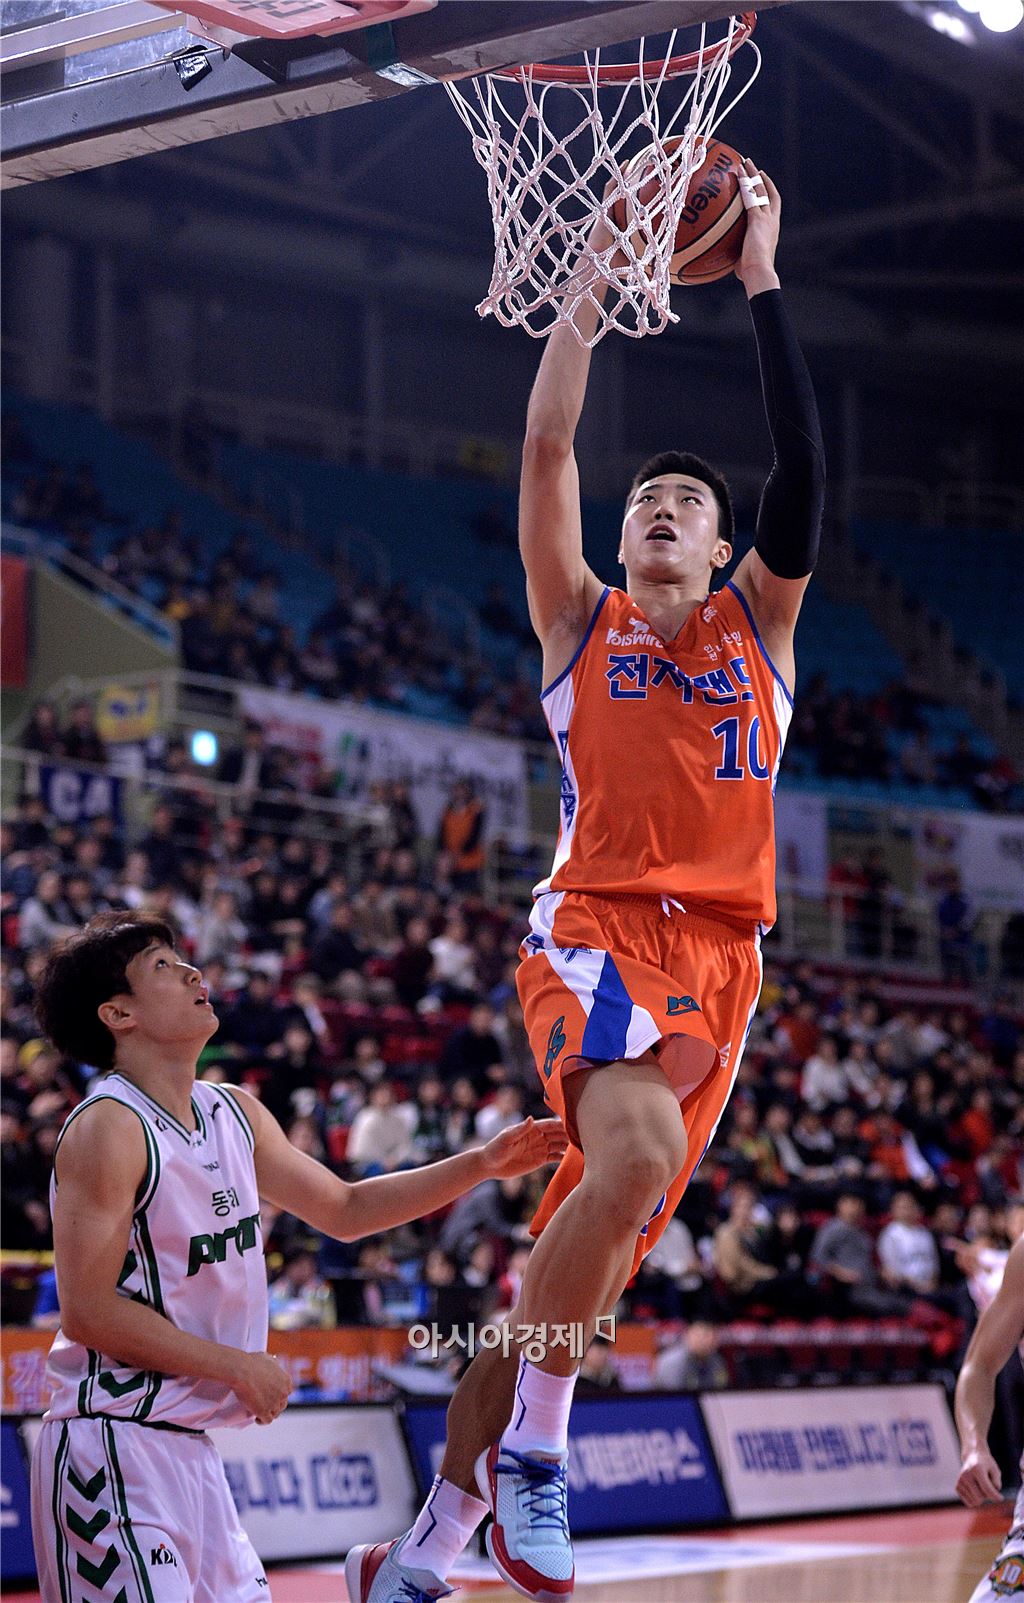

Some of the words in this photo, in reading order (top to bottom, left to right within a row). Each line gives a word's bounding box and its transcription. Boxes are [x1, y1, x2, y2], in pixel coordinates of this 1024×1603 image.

[680, 152, 734, 225] molten
[605, 653, 754, 706] 전자랜드
[710, 714, 770, 781] 10
